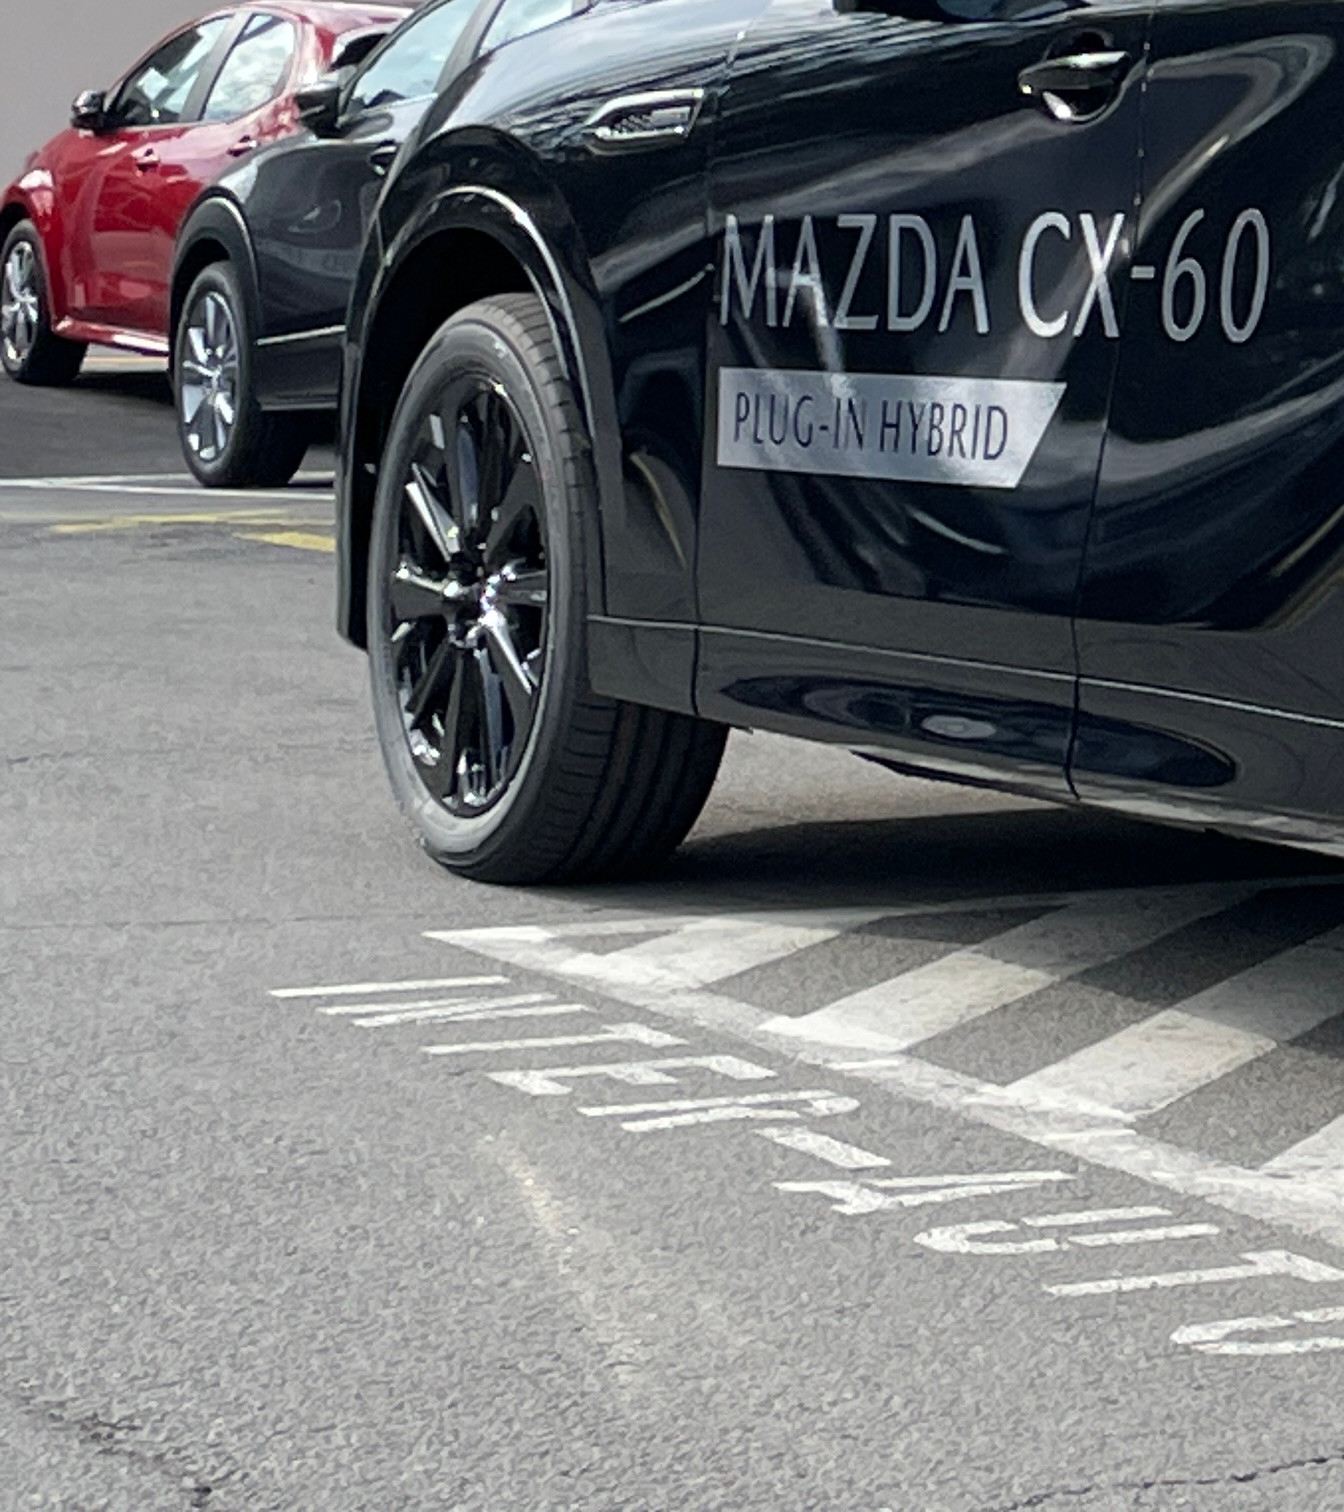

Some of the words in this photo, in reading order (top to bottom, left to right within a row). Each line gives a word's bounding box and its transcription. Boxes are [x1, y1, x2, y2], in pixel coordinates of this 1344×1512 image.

[719, 212, 991, 334] MAZDA
[1016, 206, 1271, 344] CX-60
[732, 390, 865, 452] PLUG-IN
[879, 397, 1009, 462] HYBRID
